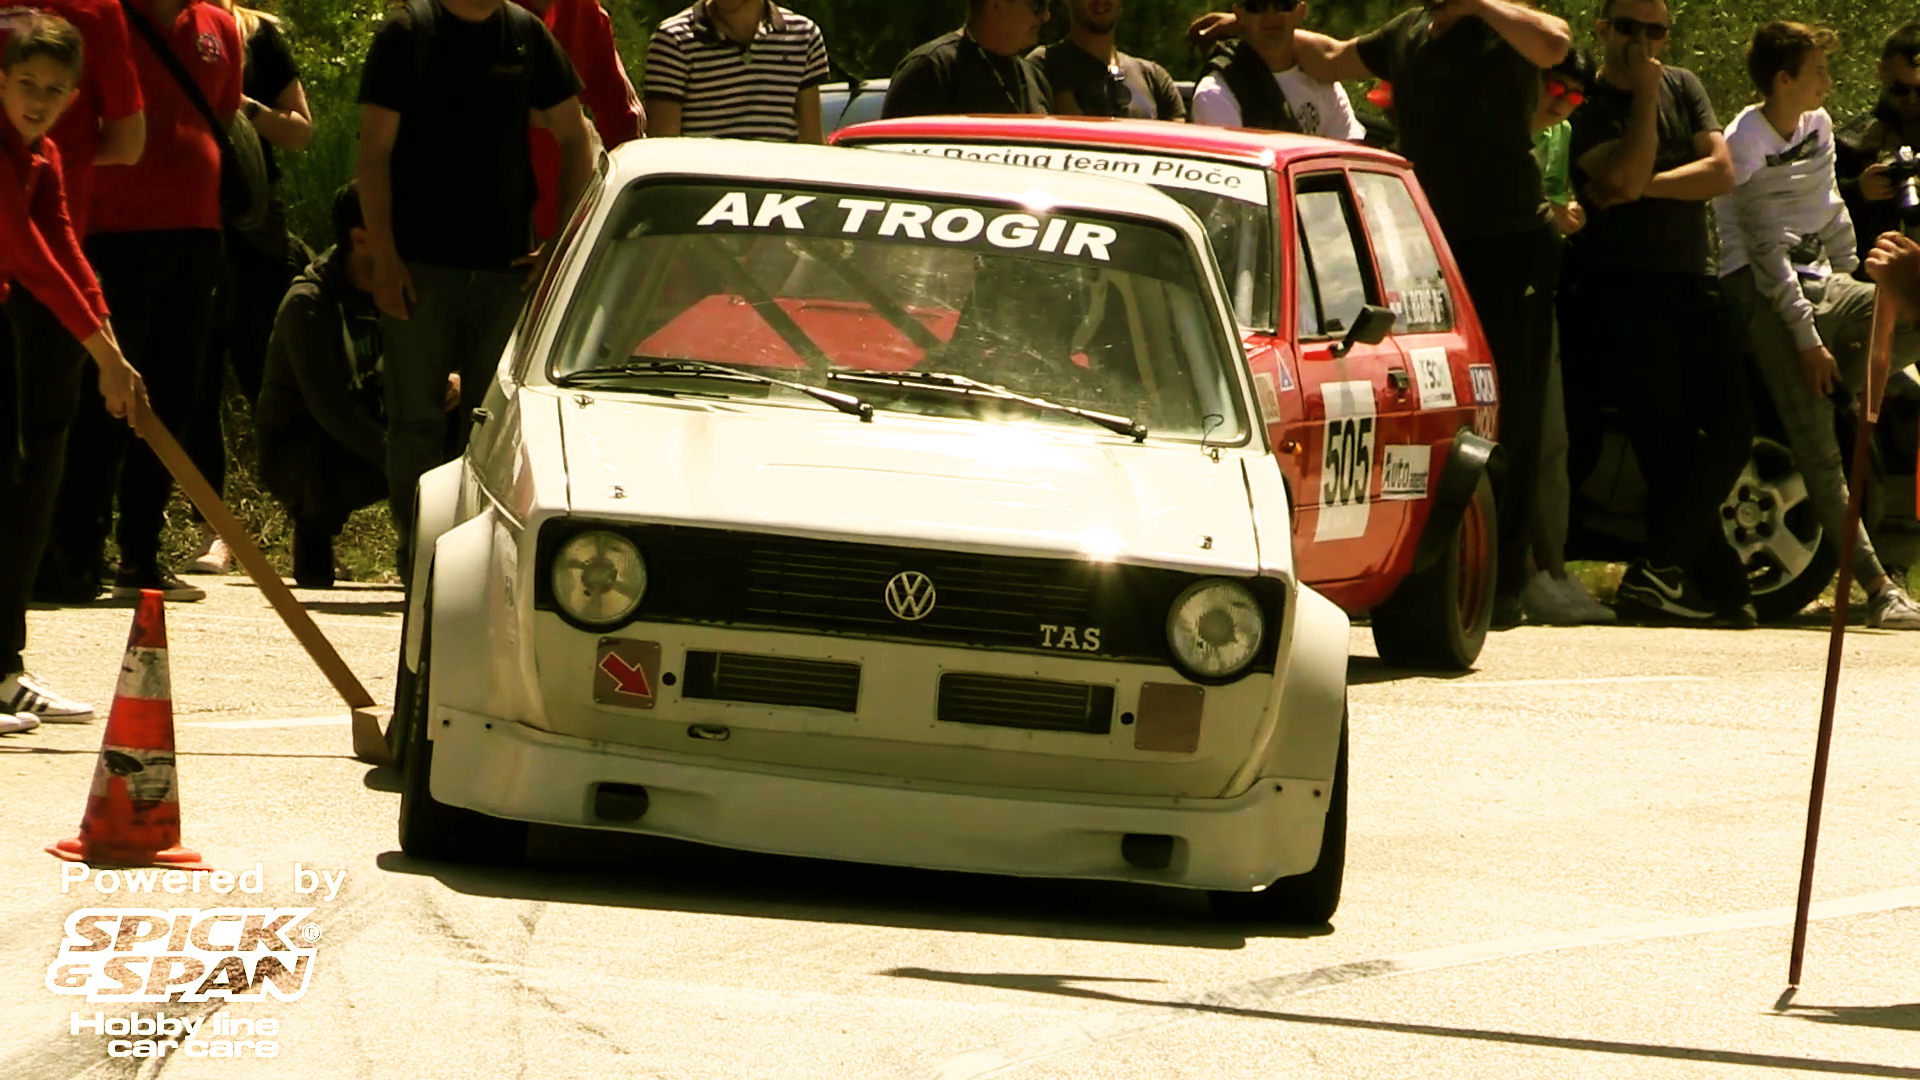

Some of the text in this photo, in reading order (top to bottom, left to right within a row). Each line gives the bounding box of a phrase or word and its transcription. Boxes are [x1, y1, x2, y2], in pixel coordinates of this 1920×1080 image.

[1062, 152, 1141, 175] team
[697, 191, 1118, 261] AK TROGIR
[1324, 417, 1373, 507] 505
[1381, 452, 1410, 488] Auto
[1039, 624, 1101, 651] TAS
